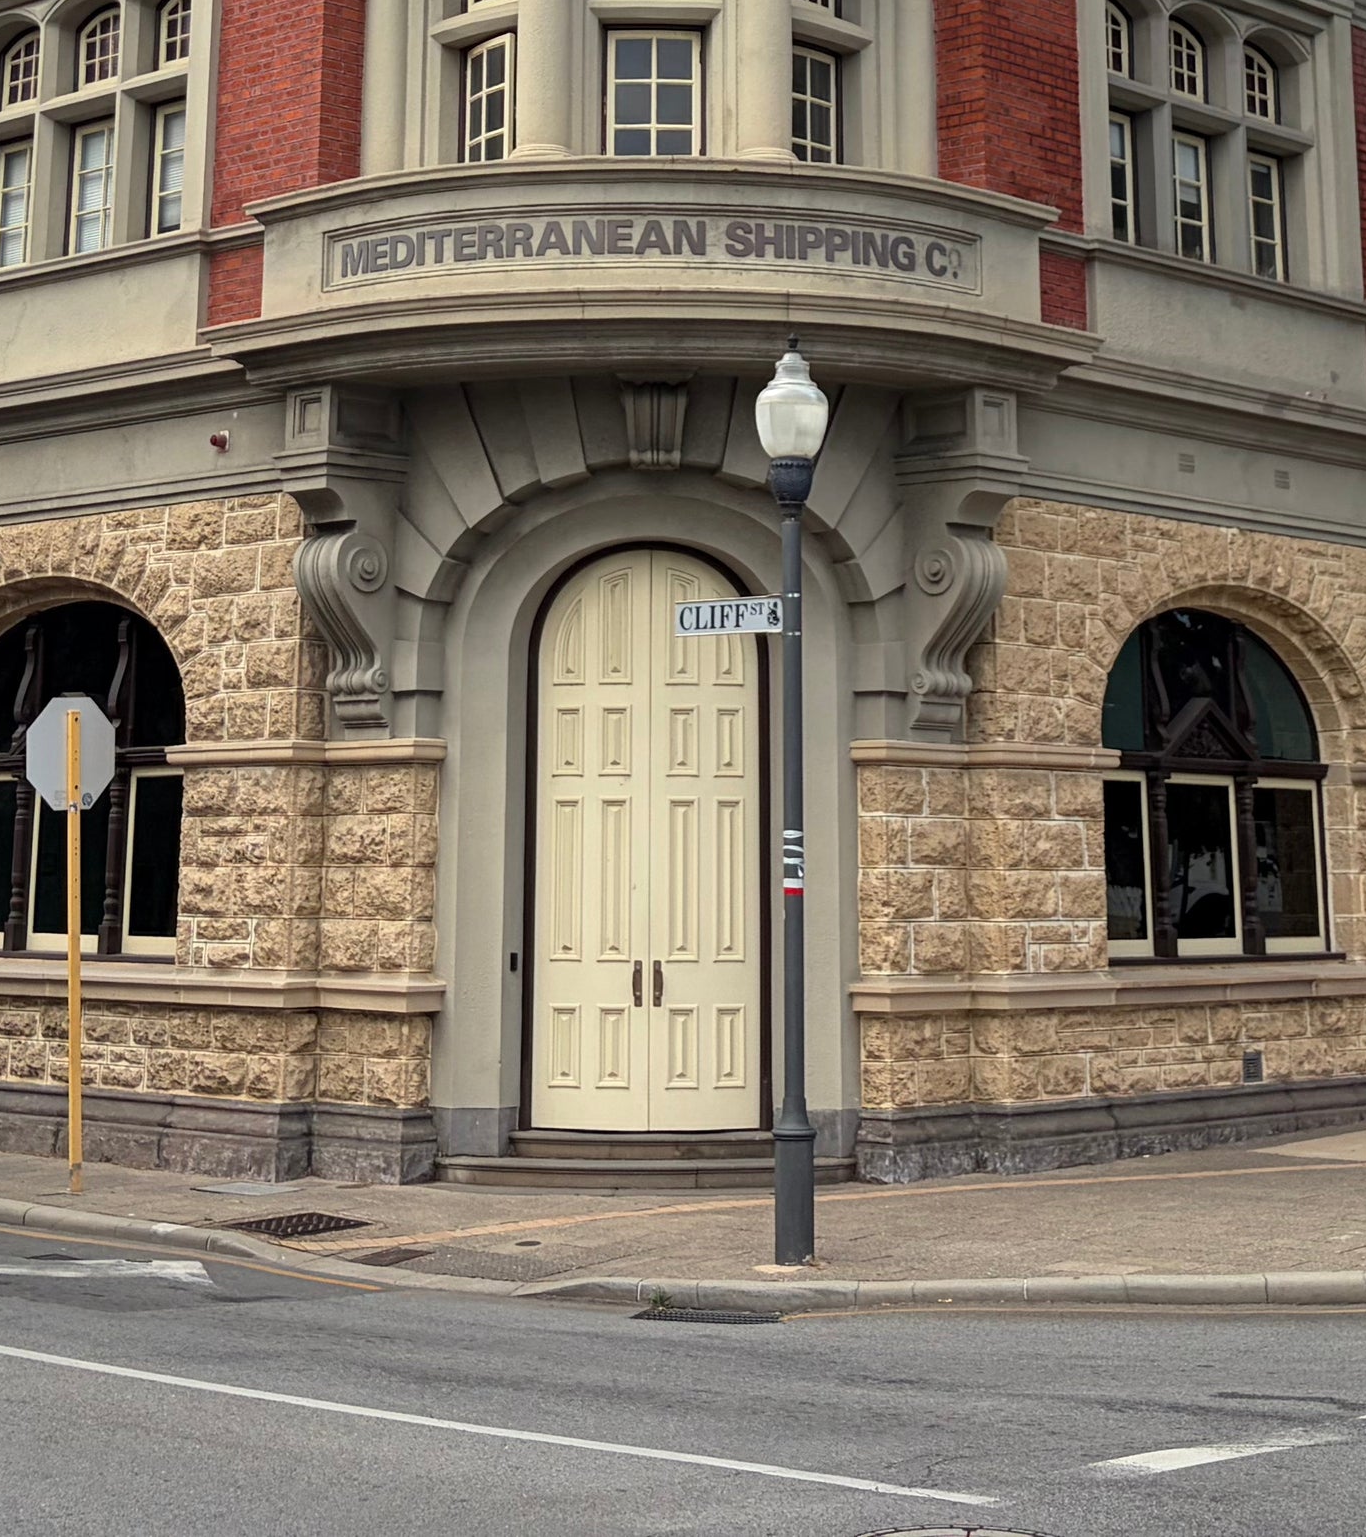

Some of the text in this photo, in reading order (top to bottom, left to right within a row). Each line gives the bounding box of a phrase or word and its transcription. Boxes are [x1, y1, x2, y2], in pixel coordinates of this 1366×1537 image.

[341, 219, 706, 278] MEDITERRANEAN
[725, 220, 916, 272] SHIPPING
[679, 602, 765, 631] CLIFF ST
